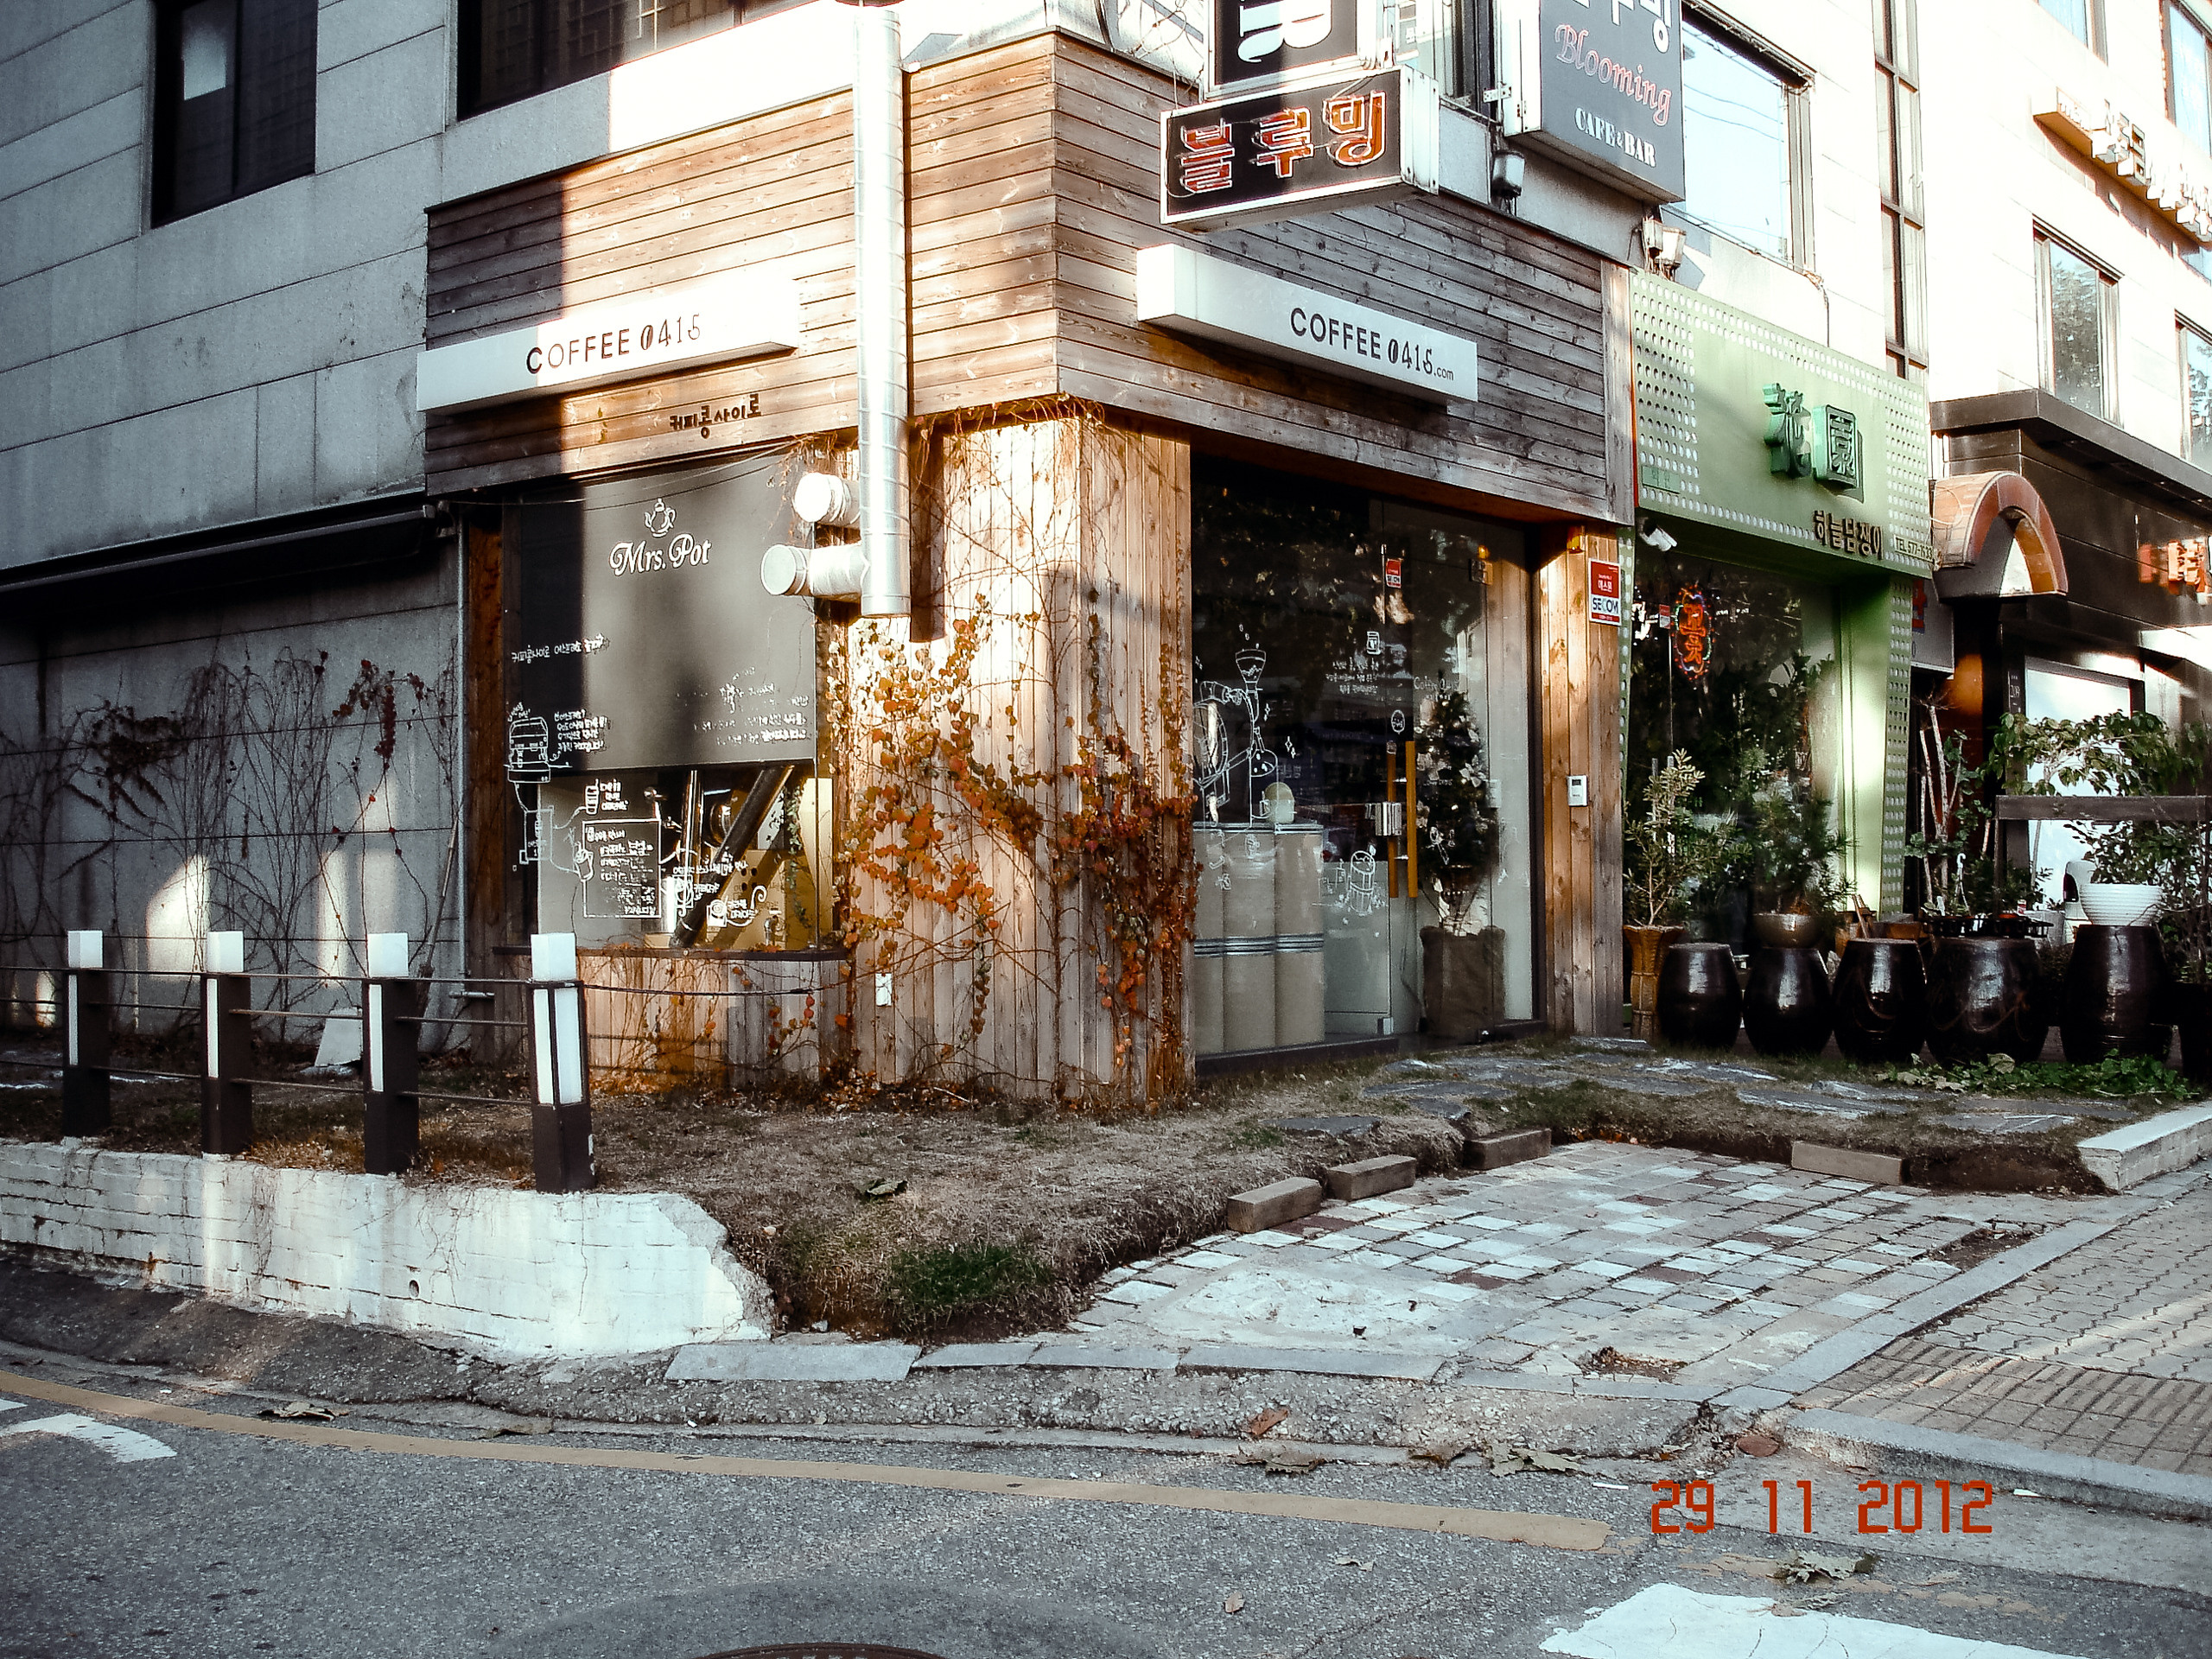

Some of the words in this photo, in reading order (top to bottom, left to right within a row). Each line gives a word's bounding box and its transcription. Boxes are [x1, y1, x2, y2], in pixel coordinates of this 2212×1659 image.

[1237, 0, 1332, 63] R
[1554, 23, 1672, 127] Blooming
[1179, 90, 1386, 194] 블루밍
[526, 328, 630, 374] COFFEE
[640, 313, 701, 351] 0415
[1290, 308, 1382, 360] COFFEE
[670, 393, 762, 439] 커피콩사이로
[609, 540, 666, 576] Mrs.
[668, 533, 712, 569] Pot
[1813, 510, 1884, 560] 하늘담쟁이
[1592, 598, 1618, 614] SECOM
